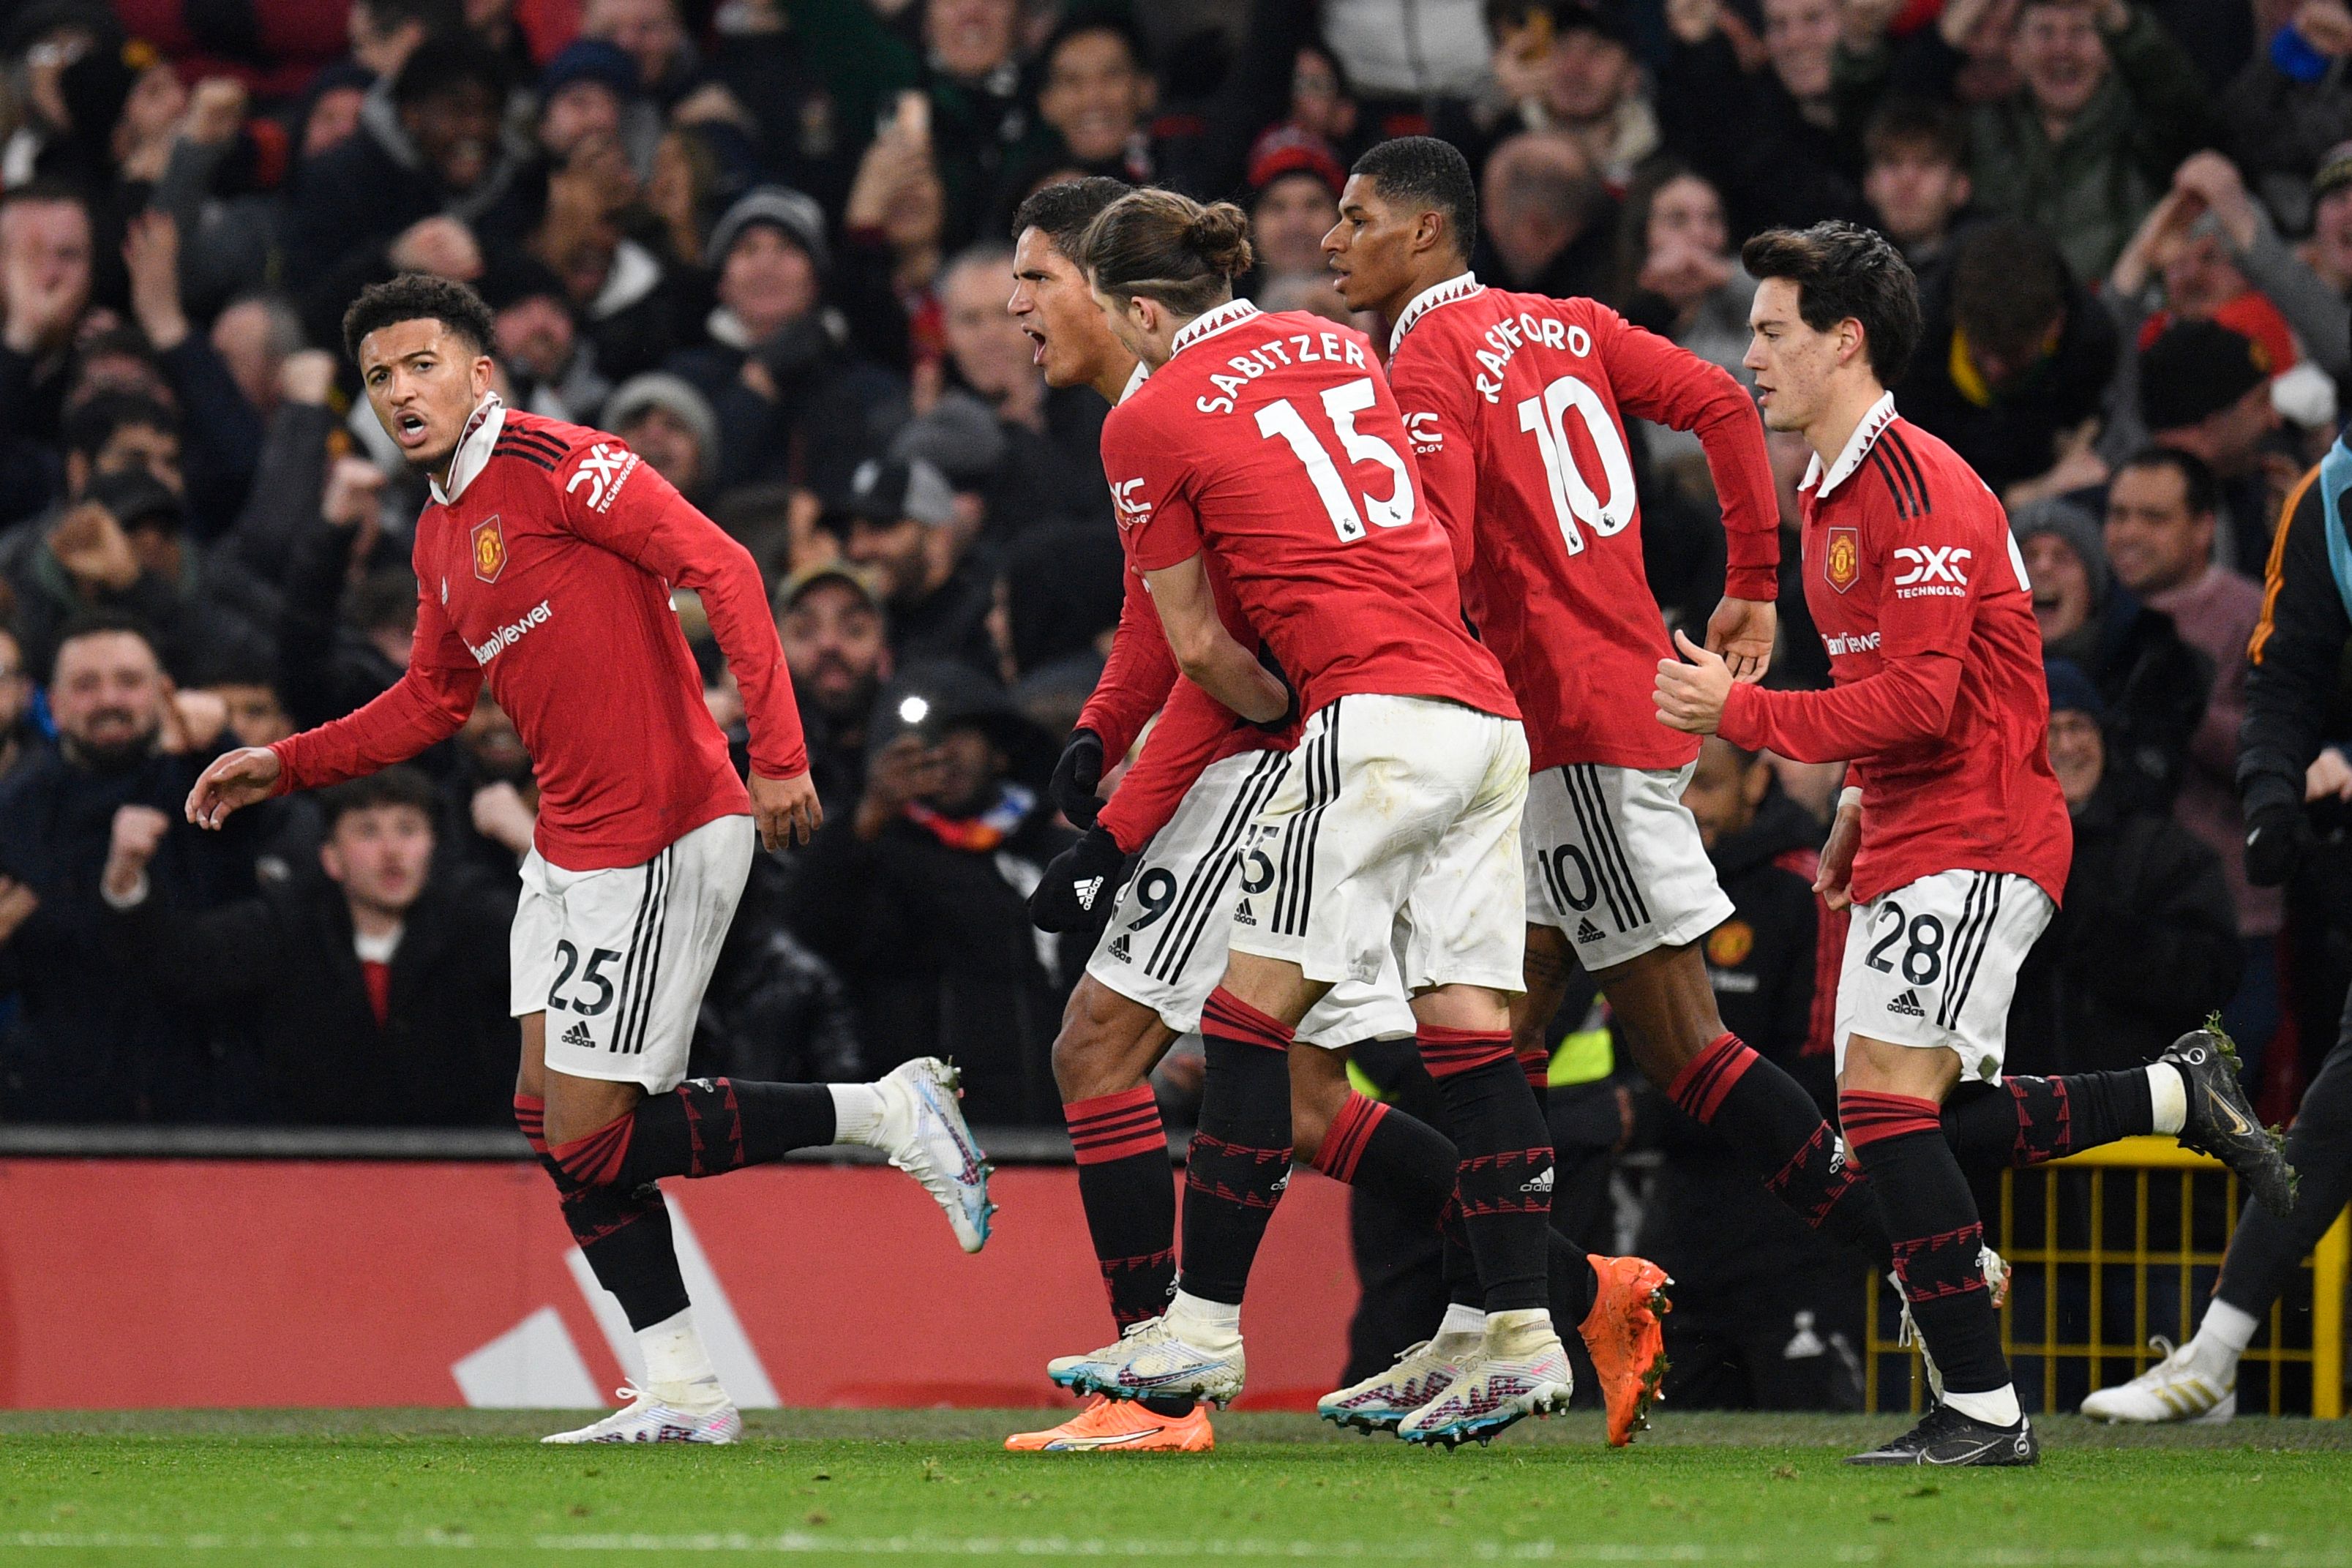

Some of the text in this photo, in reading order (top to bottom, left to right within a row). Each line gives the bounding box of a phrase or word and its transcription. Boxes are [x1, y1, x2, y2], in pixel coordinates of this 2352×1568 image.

[1196, 332, 1366, 414] SABITZER
[1254, 377, 1415, 544] 15
[1517, 375, 1636, 557] 10
[1893, 545, 1972, 585] DXC
[1083, 875, 1104, 910] adidas
[1538, 844, 1598, 916] 10
[1578, 931, 1606, 945] adidas
[1865, 901, 1944, 986] 28
[547, 939, 623, 1016] 25
[1887, 1003, 1925, 1016] adidas
[561, 1035, 596, 1049] adidas
